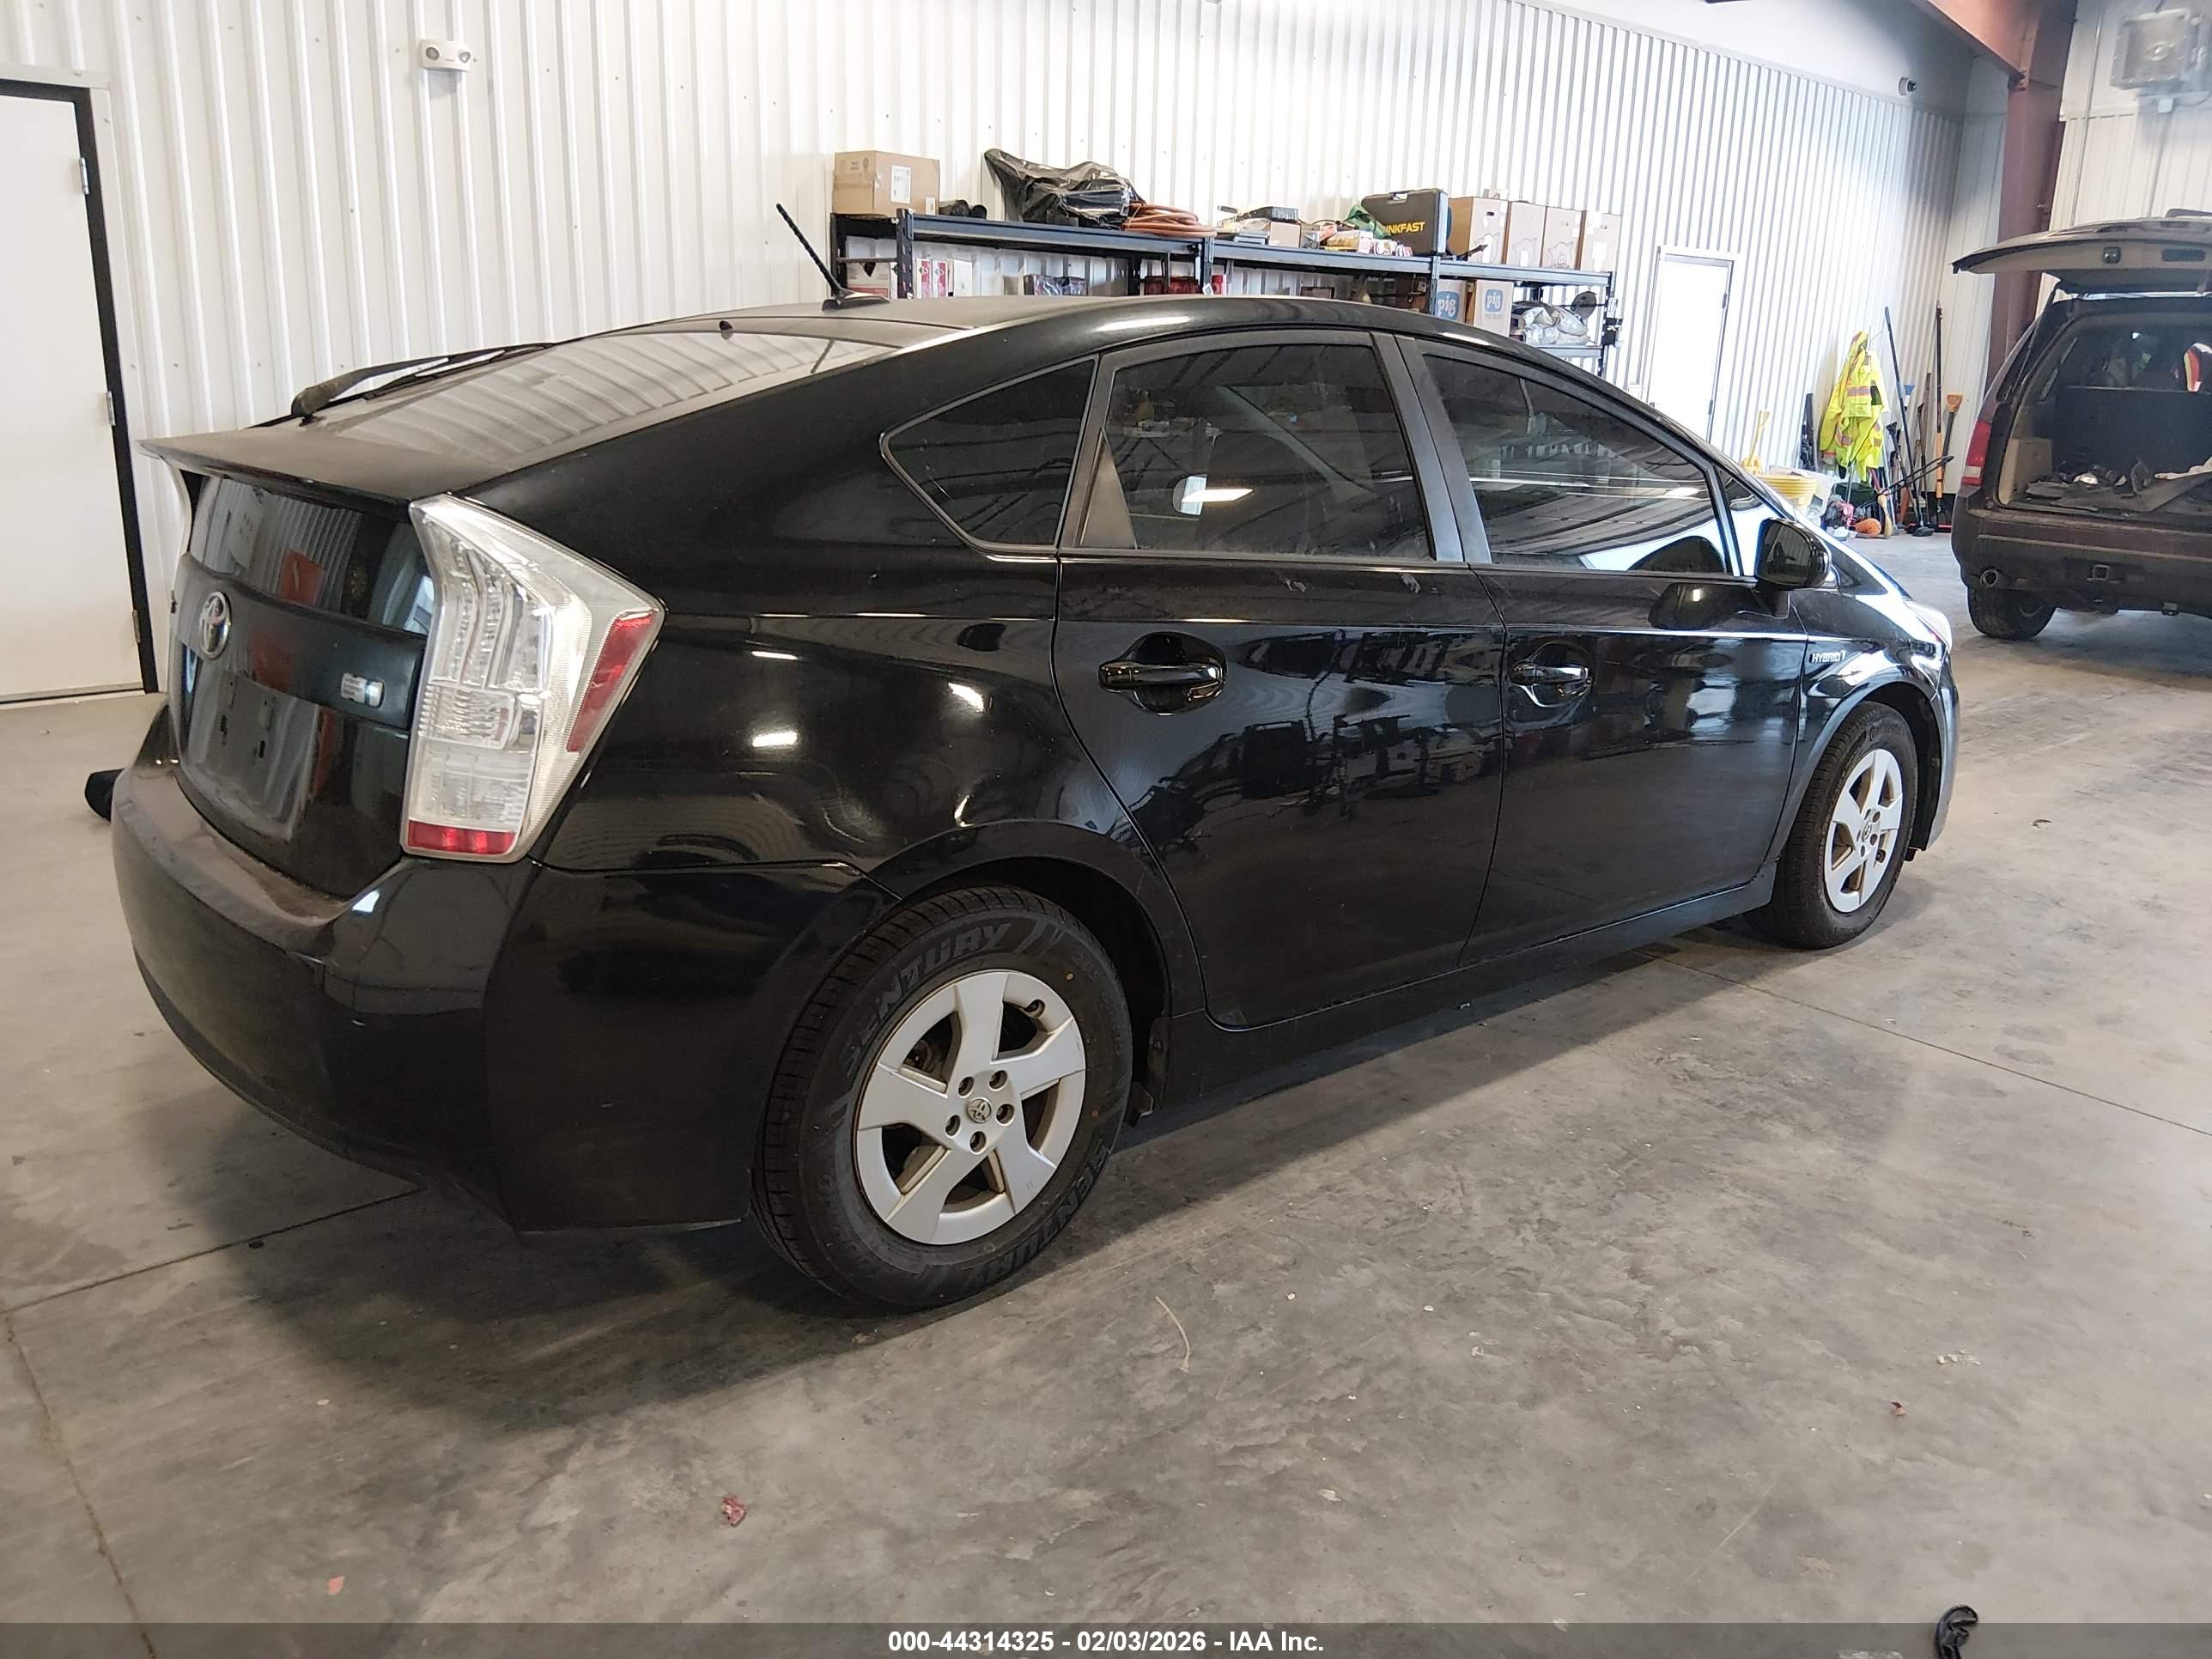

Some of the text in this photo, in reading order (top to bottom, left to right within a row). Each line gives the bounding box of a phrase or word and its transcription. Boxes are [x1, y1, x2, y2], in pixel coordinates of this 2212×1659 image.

[1437, 295, 1457, 317] pig
[1486, 292, 1501, 309] pig
[1811, 652, 1841, 664] HYBRID
